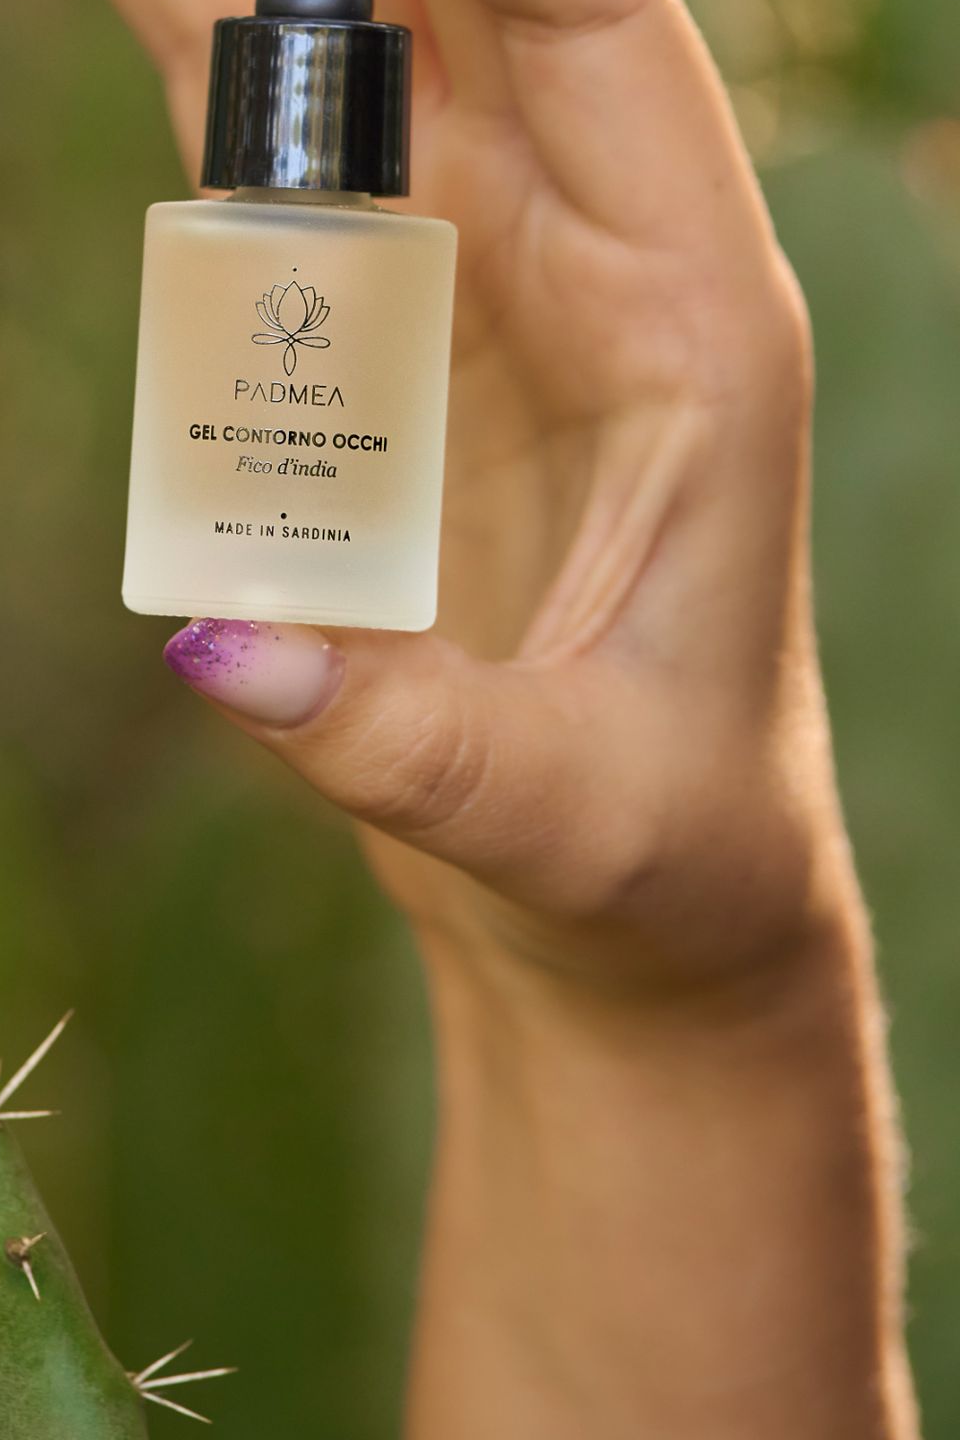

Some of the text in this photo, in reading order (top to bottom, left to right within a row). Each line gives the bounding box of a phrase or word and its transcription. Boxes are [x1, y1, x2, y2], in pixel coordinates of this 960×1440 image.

[234, 379, 345, 408] PADMEA
[189, 423, 388, 452] GEL CONTORNO OCCHI
[235, 456, 338, 478] Fico d'india
[214, 521, 351, 542] MADE IN SARDINIA
